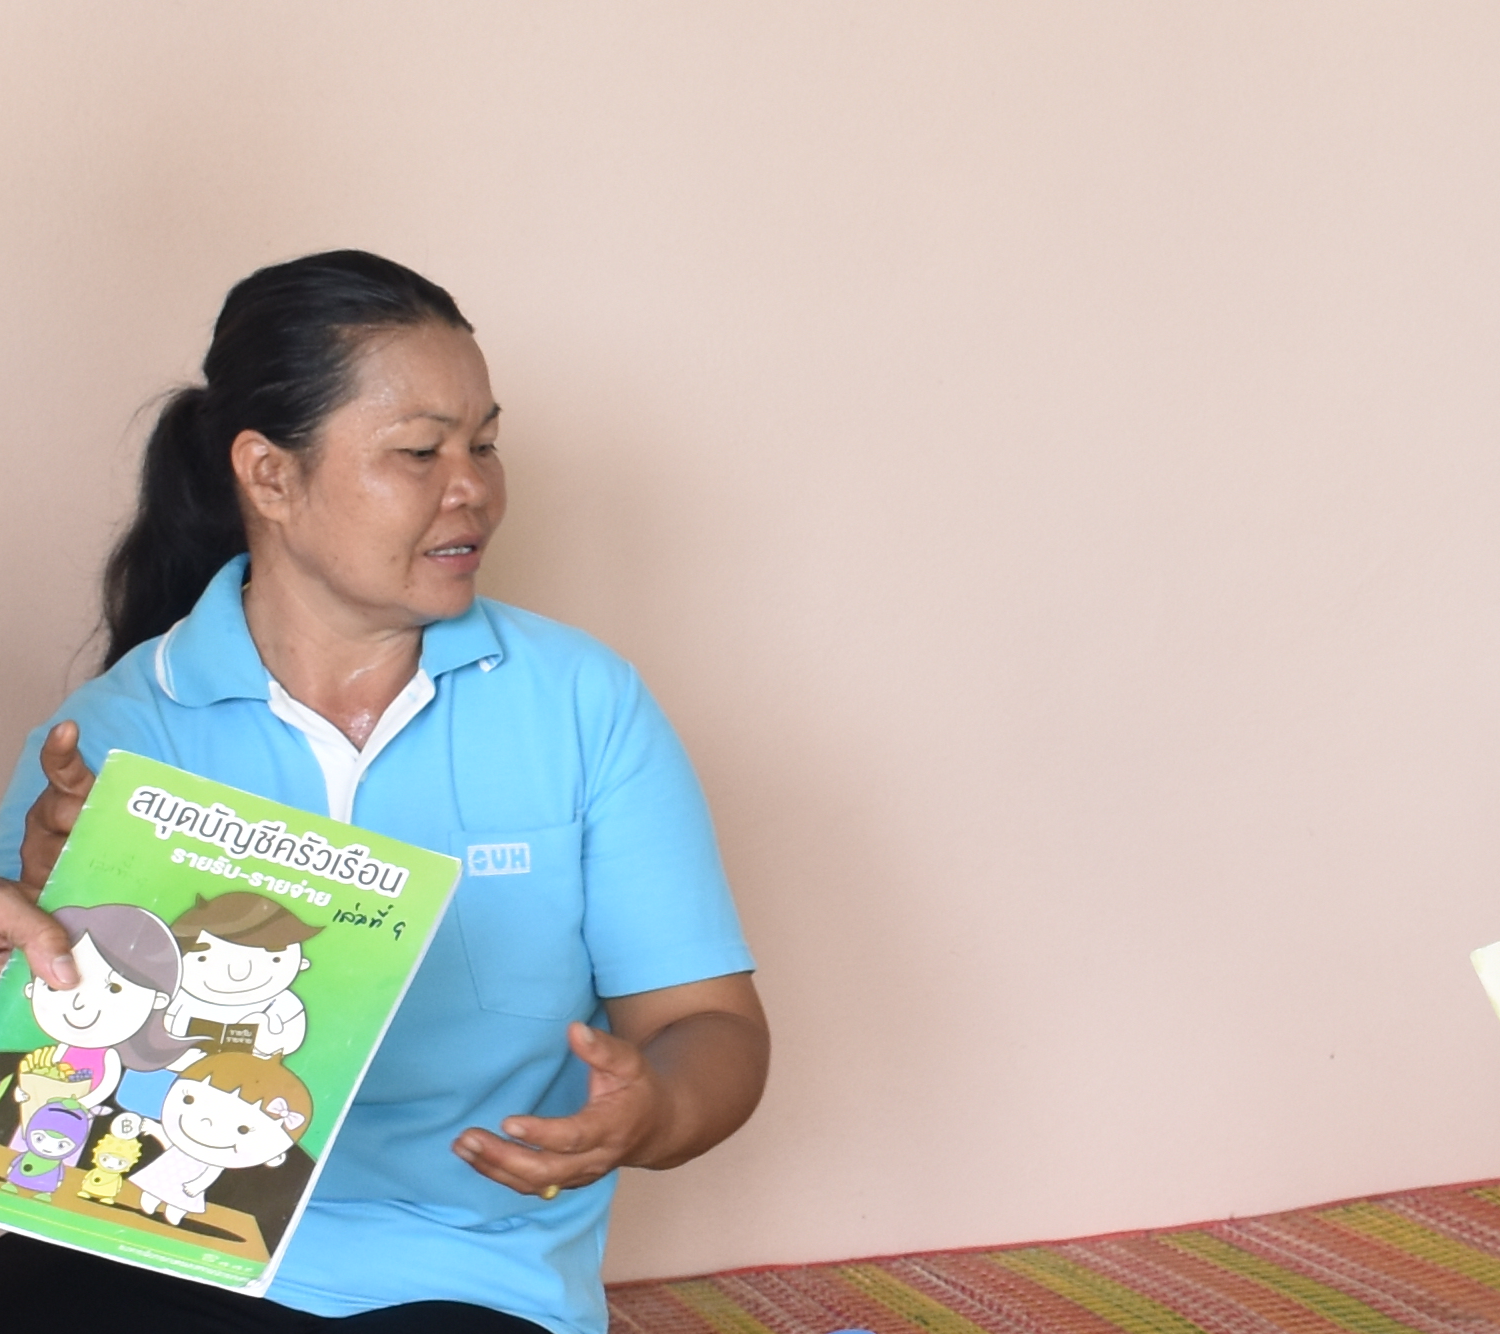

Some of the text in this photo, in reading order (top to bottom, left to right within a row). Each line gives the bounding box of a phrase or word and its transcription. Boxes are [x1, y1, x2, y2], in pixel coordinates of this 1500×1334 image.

[131, 789, 404, 894] สมุดบัญชีครัวเรือน
[170, 848, 333, 908] รายรับ-รายจ่าย
